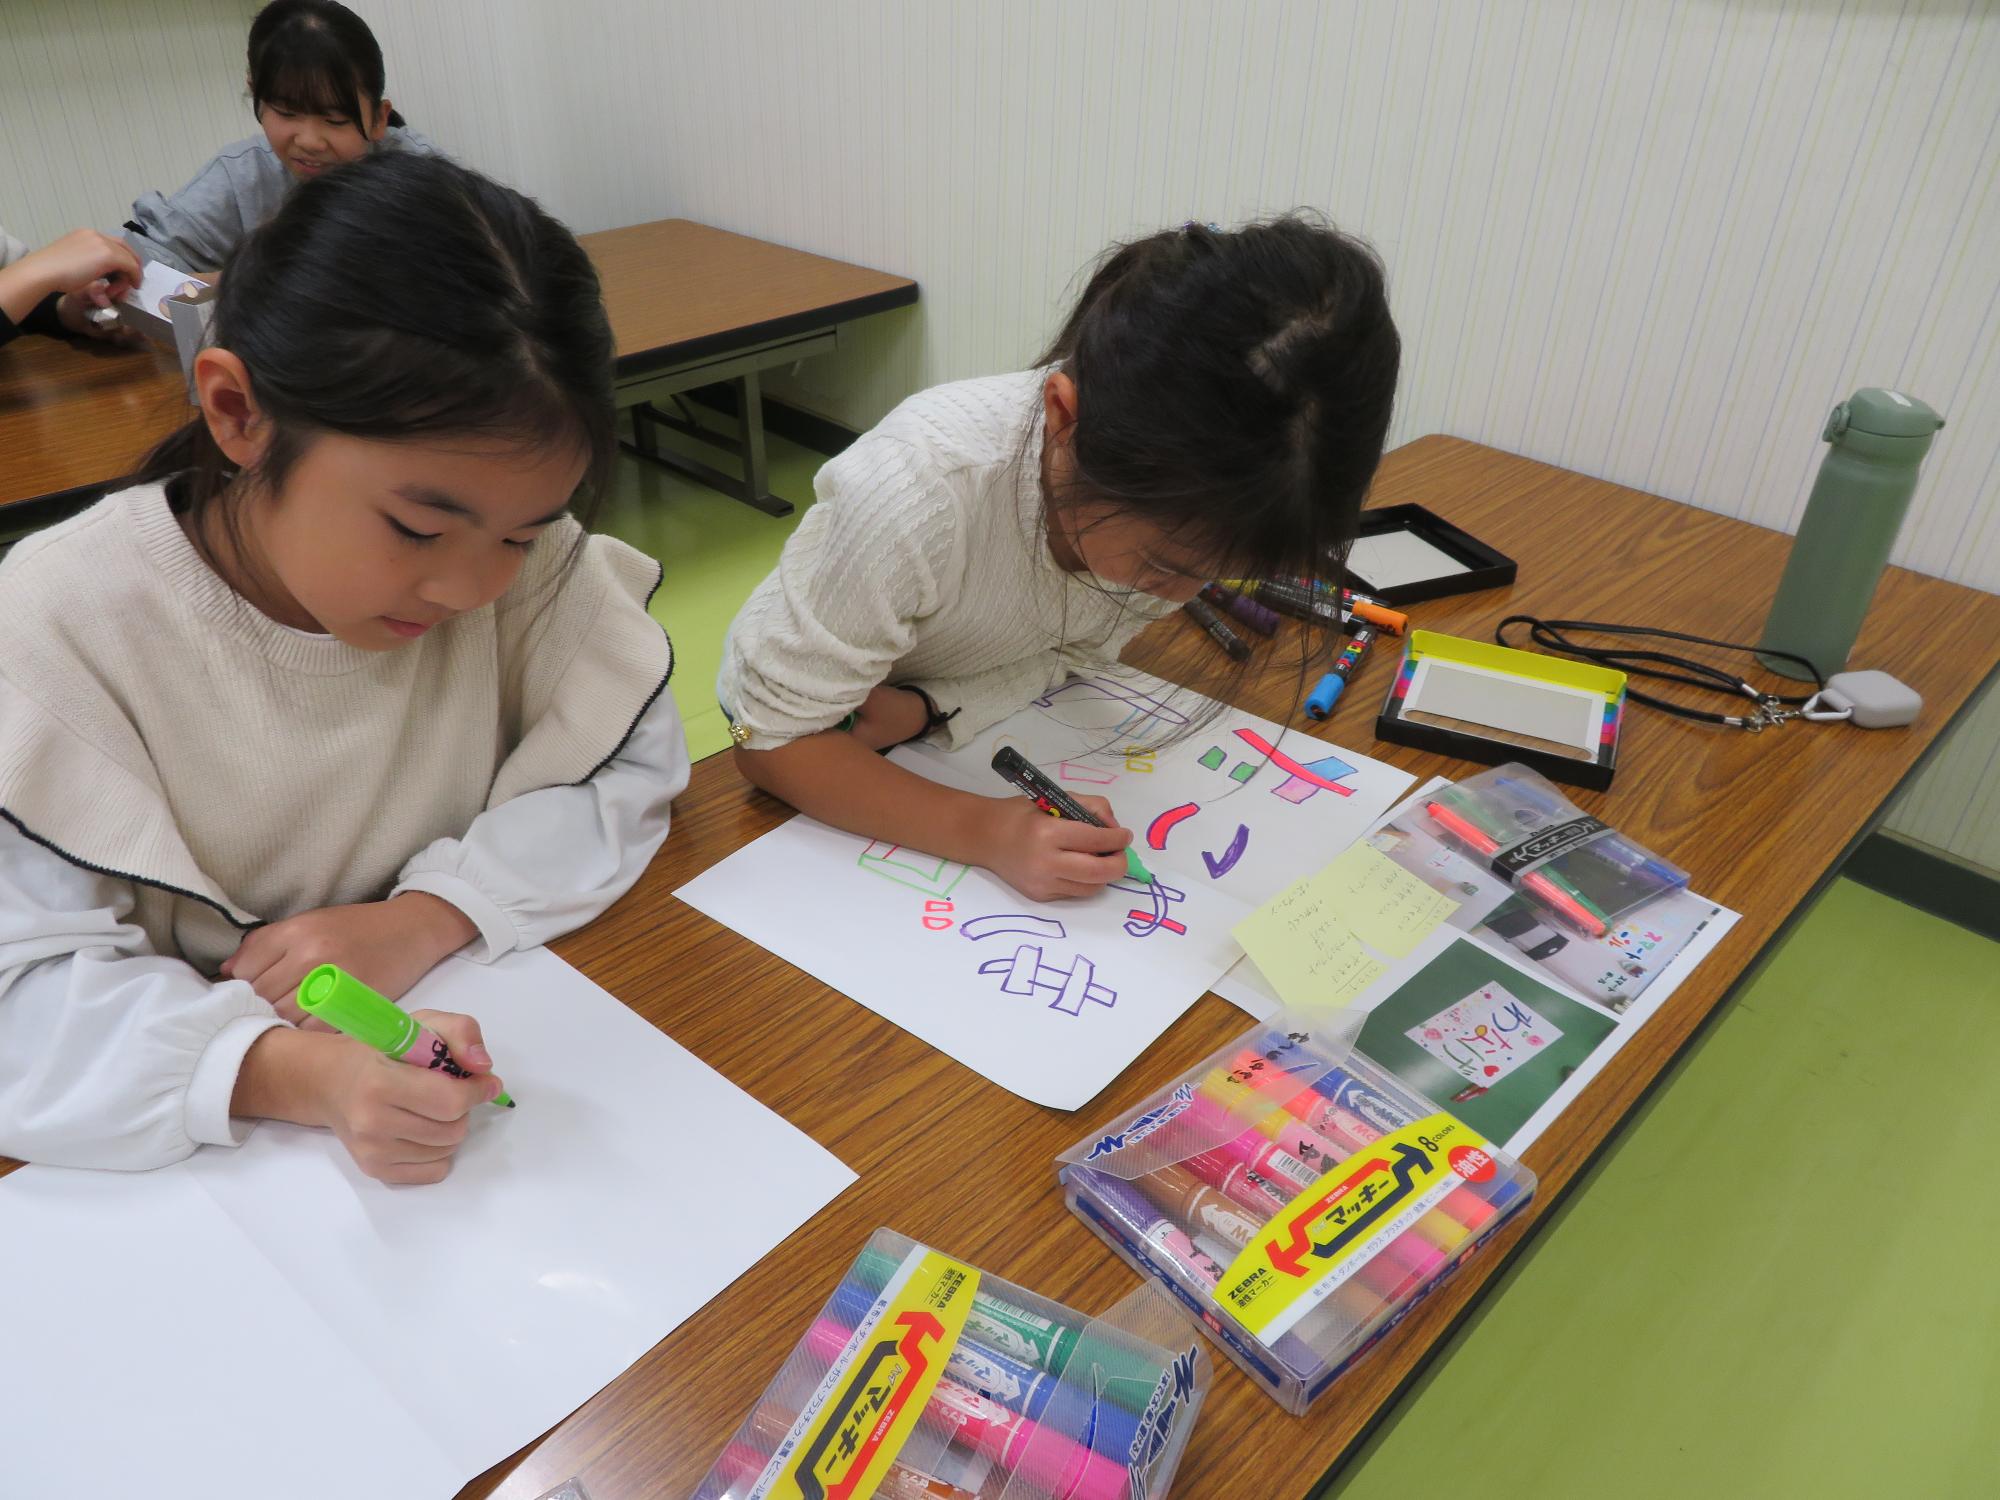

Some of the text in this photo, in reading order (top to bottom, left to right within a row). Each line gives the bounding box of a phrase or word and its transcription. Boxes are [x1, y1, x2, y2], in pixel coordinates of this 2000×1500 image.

[1443, 1002, 1532, 1073] わなげ
[1418, 1124, 1456, 1152] 8 COLORS
[1452, 1151, 1490, 1179] 油性
[926, 1267, 955, 1306] 油性マーカー
[938, 1269, 967, 1311] ZEBRA
[1227, 1267, 1266, 1299] ZEBRA
[1236, 1275, 1274, 1308] 油性マーカー
[873, 1408, 896, 1442] ZEBRA
